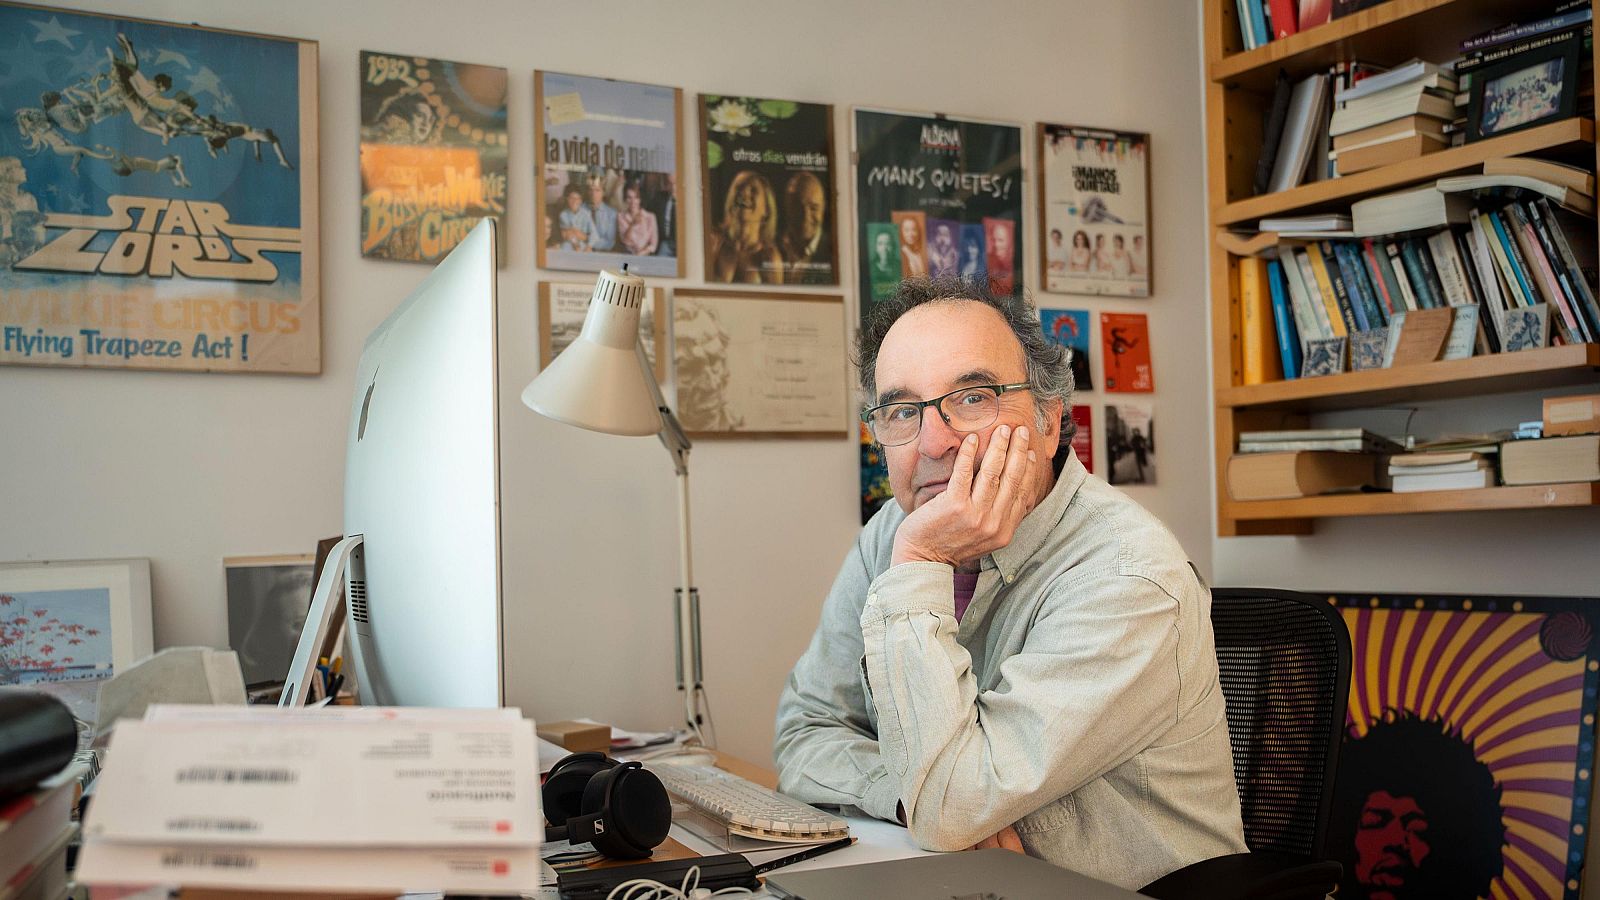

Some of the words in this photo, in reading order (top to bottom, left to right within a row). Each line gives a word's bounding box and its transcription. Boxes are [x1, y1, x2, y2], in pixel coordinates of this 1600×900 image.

[544, 133, 561, 164] la
[563, 135, 600, 165] vida
[604, 139, 626, 169] de
[732, 148, 762, 164] otros
[867, 166, 925, 190] MANS
[931, 162, 1013, 200] QUIETES!
[12, 231, 302, 284] LORDS
[153, 300, 300, 335] CIRCUS
[4, 327, 73, 358] Flying
[79, 329, 182, 360] Trapeze
